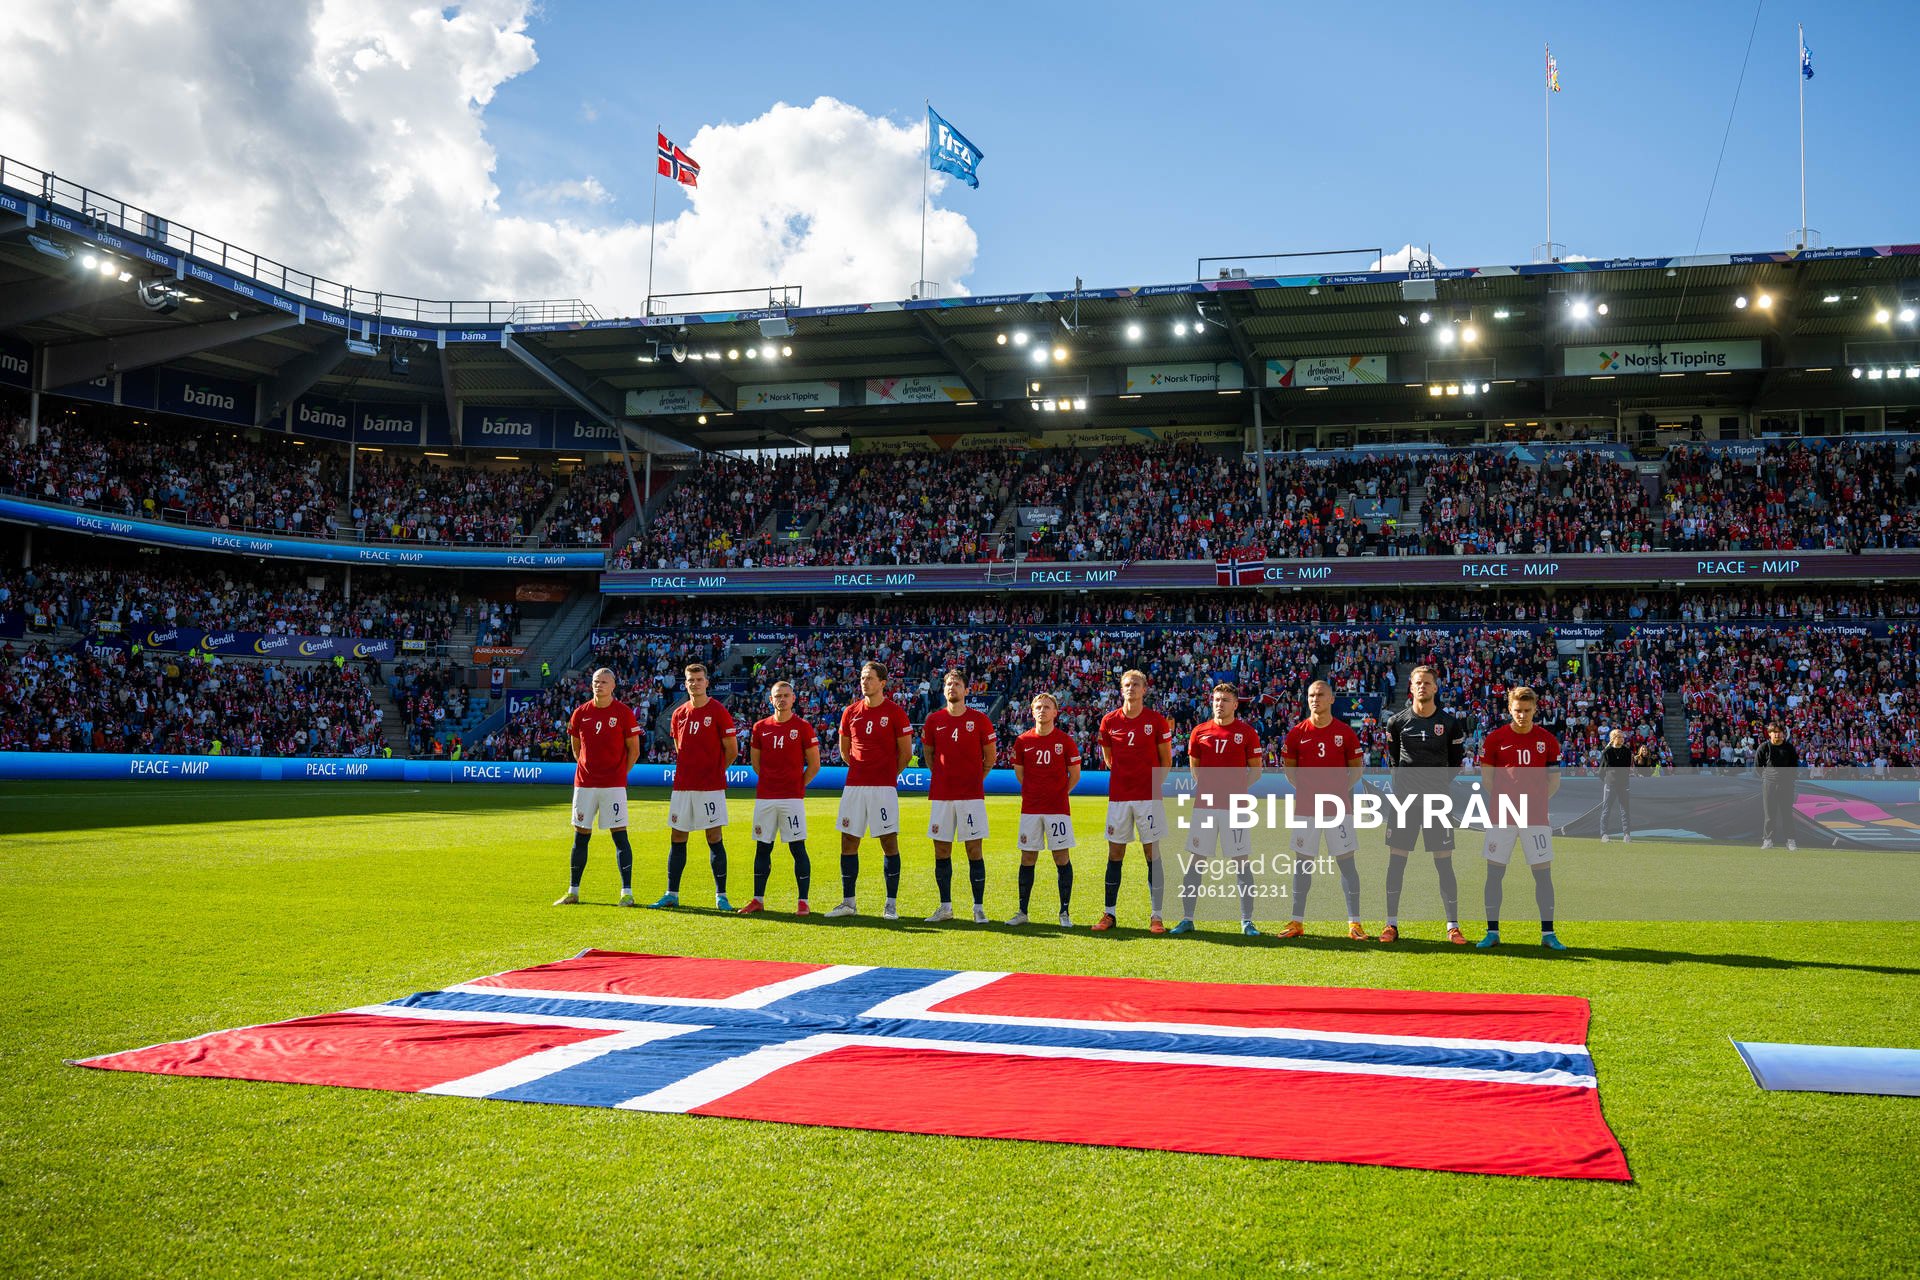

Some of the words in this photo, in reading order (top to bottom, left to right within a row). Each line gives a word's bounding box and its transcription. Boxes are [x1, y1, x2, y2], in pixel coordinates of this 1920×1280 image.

[938, 124, 972, 166] FIFA
[1625, 352, 1668, 367] Norsk
[1671, 351, 1726, 367] Tipping
[1165, 374, 1188, 383] Norsk
[1190, 373, 1220, 383] Tipping
[184, 384, 235, 410] bama
[792, 392, 819, 402] Tipping
[300, 404, 347, 428] bama
[363, 415, 413, 432] bama
[482, 418, 532, 436] bama
[76, 516, 102, 529] PEACE
[211, 536, 241, 548] PEACE
[360, 551, 390, 560] PEACE
[507, 556, 536, 565] PEACE
[1462, 564, 1508, 577] PEACE
[1698, 561, 1746, 574] PEACE
[651, 577, 686, 588] PEACE
[835, 574, 873, 586] PEACE
[1031, 571, 1072, 583] PEACE
[153, 630, 178, 643] Bendit
[1560, 627, 1582, 636] Norsk
[1642, 627, 1664, 636] Norsk
[1837, 626, 1868, 636] Tipping
[209, 634, 235, 647] Bendit
[261, 637, 288, 650] Bendit
[306, 639, 333, 653] Bendit
[361, 641, 388, 655] Bendit
[595, 720, 602, 735] 9
[689, 720, 700, 735] 19
[865, 720, 873, 735] 8
[773, 735, 784, 749] 14
[952, 728, 959, 742] 4
[1127, 731, 1135, 746] 2
[1215, 739, 1228, 754] 17
[1318, 742, 1326, 758] 3
[1036, 750, 1051, 765] 20
[1517, 750, 1531, 765] 10
[131, 760, 168, 774] PEACE
[306, 764, 337, 776] PEACE
[463, 766, 501, 778] PEACE
[896, 773, 923, 786] ACE
[613, 802, 620, 816] 9
[704, 801, 716, 816] 19
[880, 807, 888, 822] 8
[787, 815, 799, 829] 14
[967, 813, 974, 827] 4
[1147, 815, 1155, 829] 2
[1051, 821, 1066, 837] 20
[1338, 825, 1347, 840] 3
[1232, 829, 1244, 844] 17
[1533, 833, 1546, 849] 10
